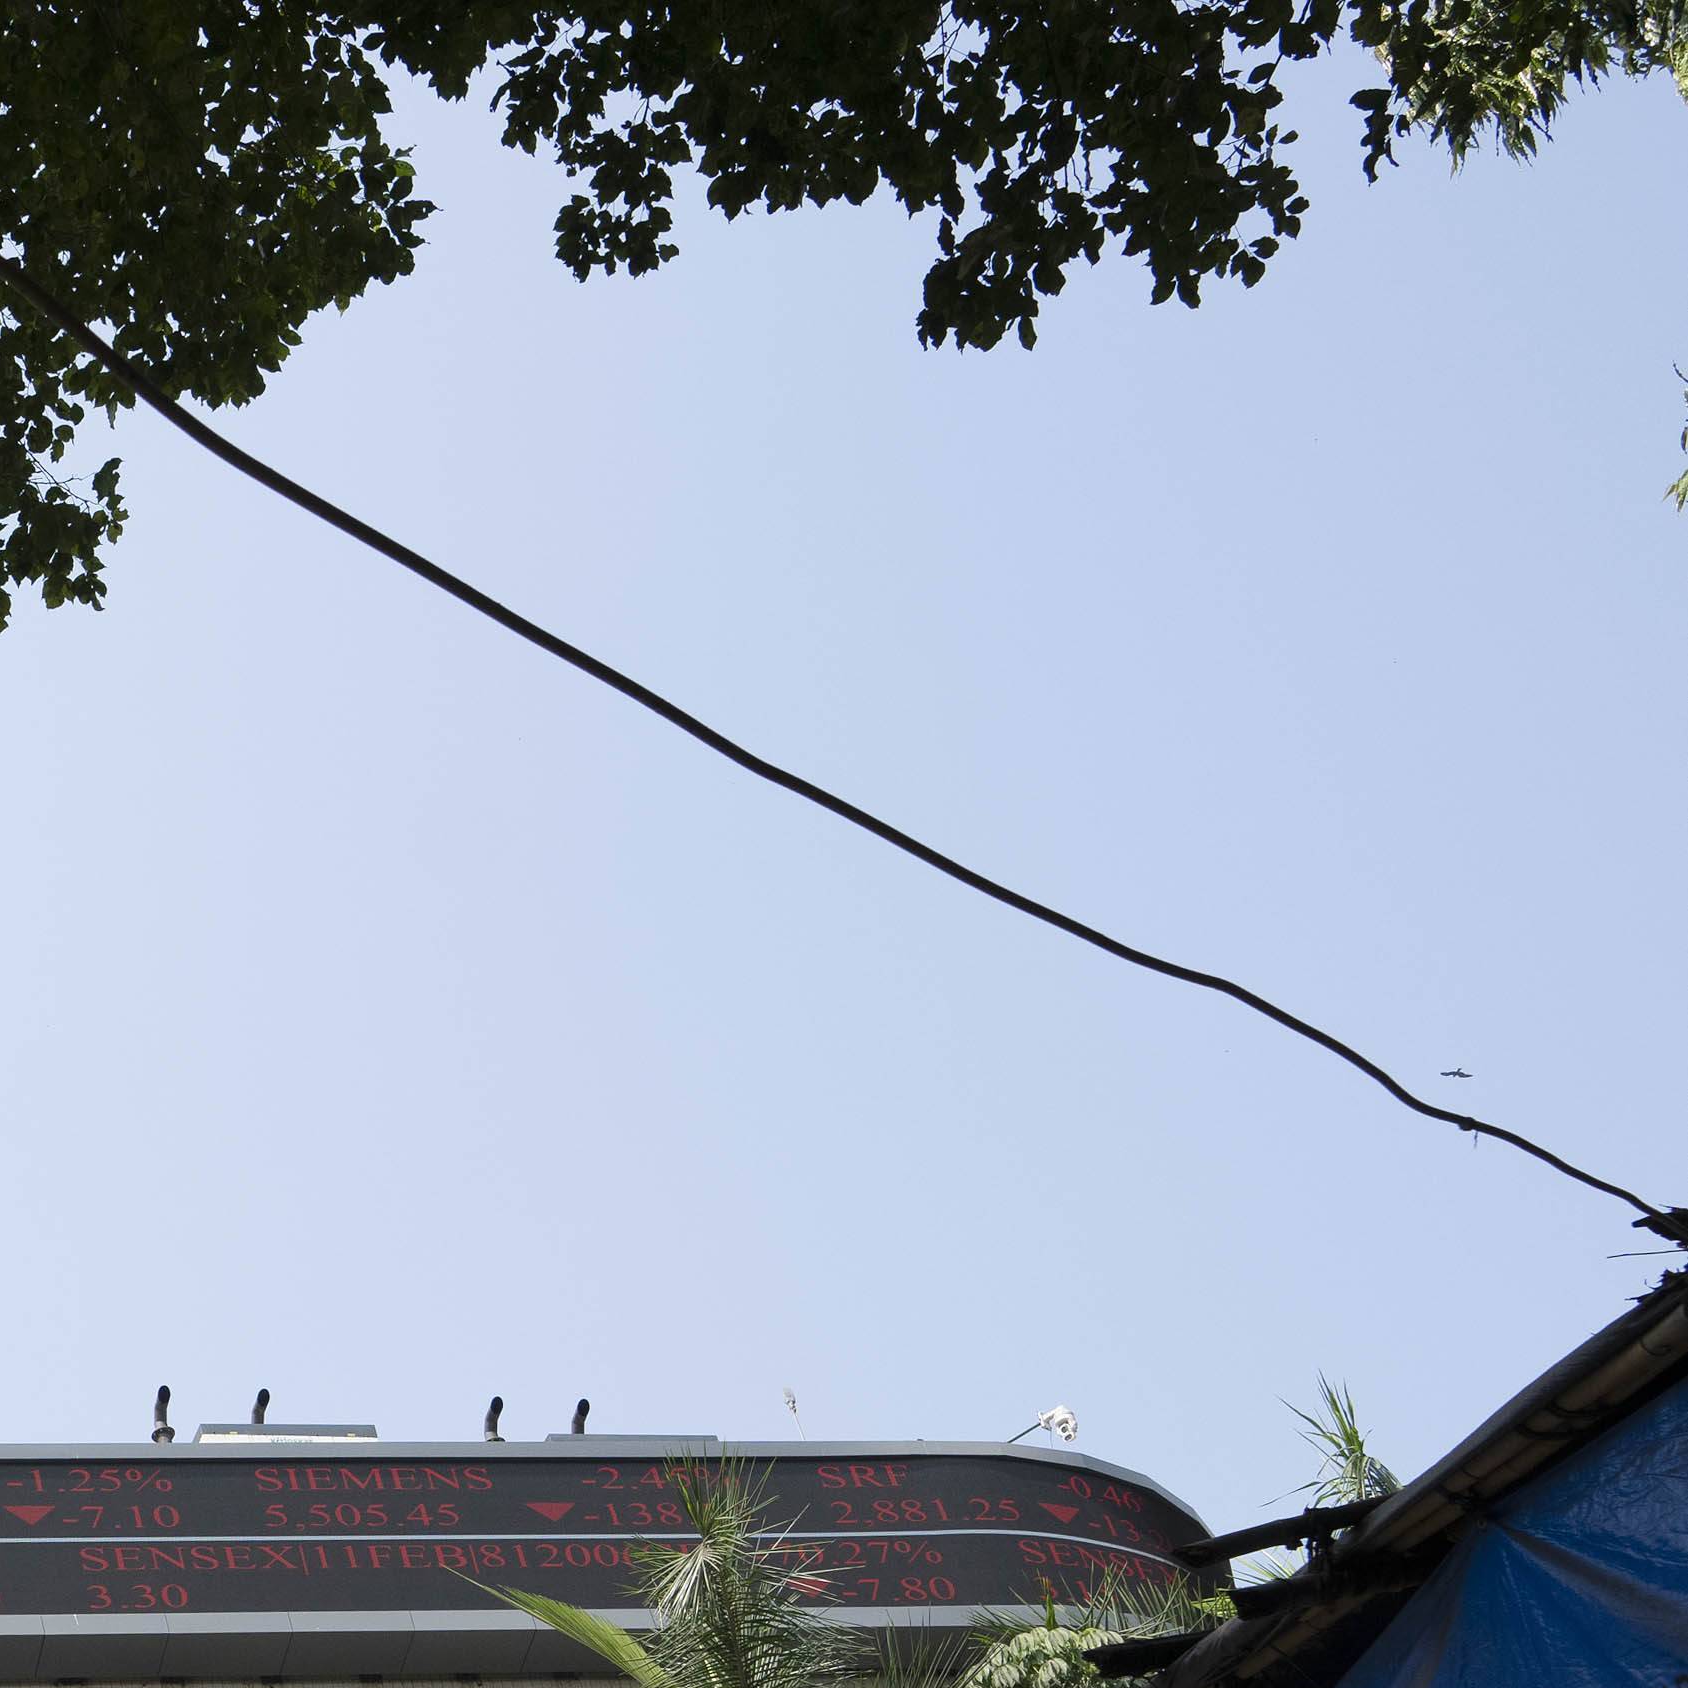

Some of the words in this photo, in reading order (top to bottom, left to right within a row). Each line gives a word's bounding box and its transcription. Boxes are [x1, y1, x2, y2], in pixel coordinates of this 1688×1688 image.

[7, 1467, 173, 1493] -1.25%
[255, 1465, 493, 1493] SIEMENS
[817, 1463, 910, 1489] SRF
[62, 1504, 181, 1529] -7.10
[263, 1502, 460, 1530] 5,505.45
[830, 1497, 1021, 1525] 2,881.25
[86, 1582, 189, 1610] 3.30
[842, 1575, 956, 1601] -7.80
